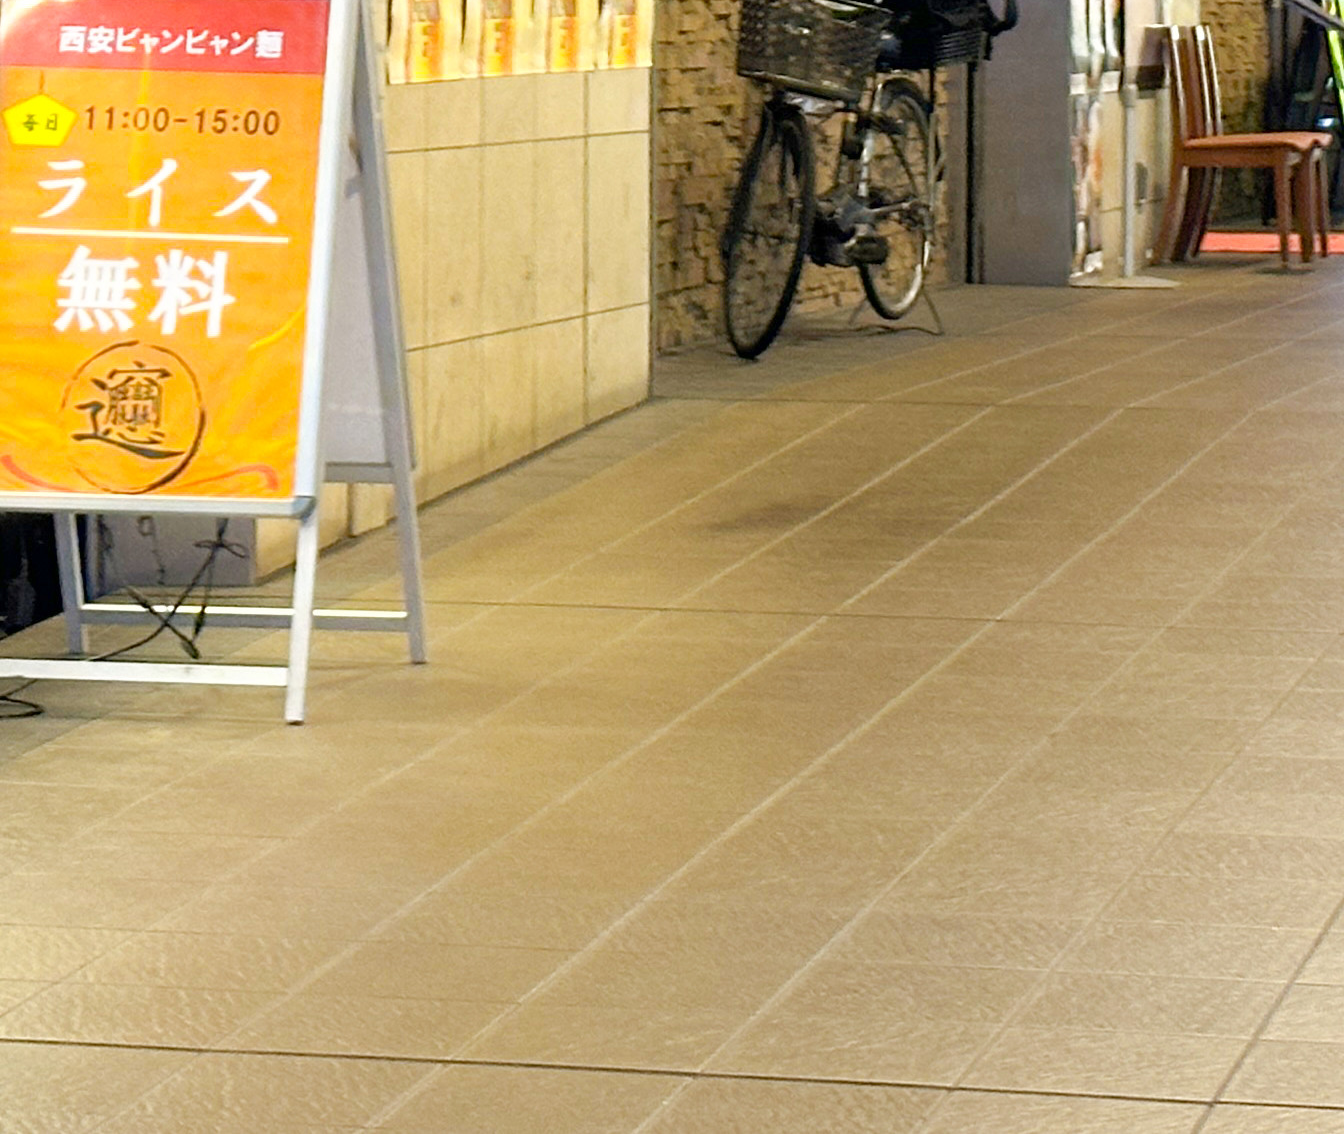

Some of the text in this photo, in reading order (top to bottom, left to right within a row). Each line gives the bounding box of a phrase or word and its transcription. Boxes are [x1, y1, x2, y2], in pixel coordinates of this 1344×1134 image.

[58, 24, 286, 60] 西安ビャンビャン麺
[84, 105, 282, 136] 11:00-15:00
[36, 157, 281, 229] ライス
[52, 242, 238, 340] 無料
